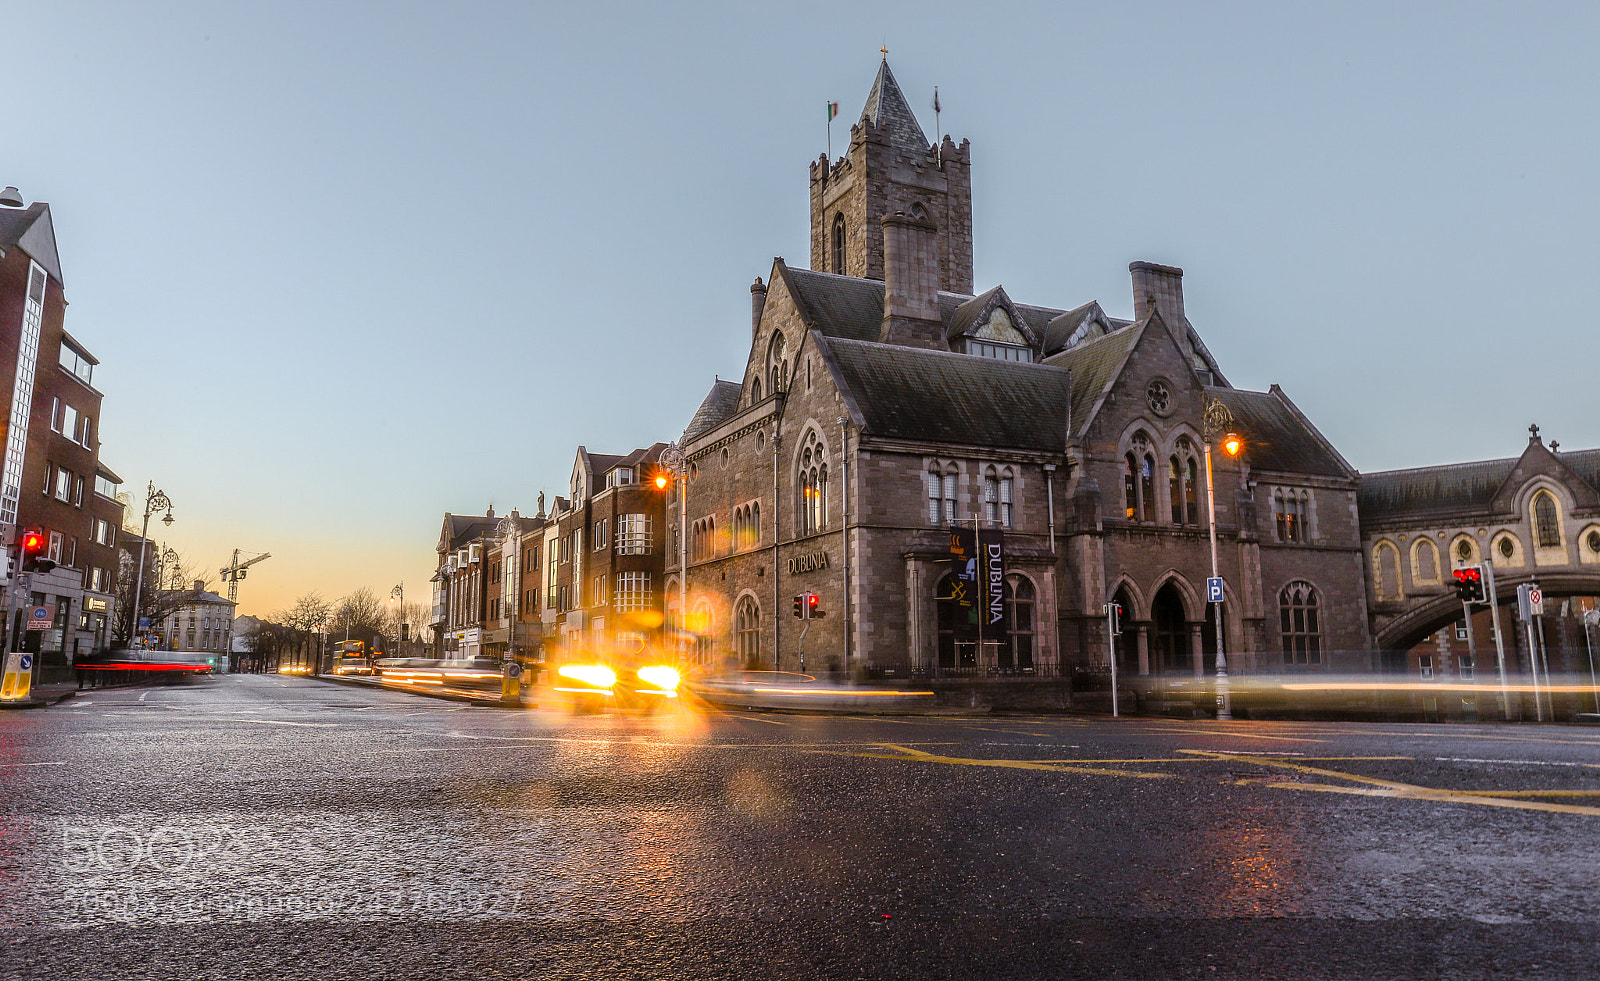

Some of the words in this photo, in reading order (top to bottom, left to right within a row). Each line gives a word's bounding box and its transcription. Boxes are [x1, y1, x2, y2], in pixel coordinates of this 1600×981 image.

[787, 551, 828, 574] DUBLINIA
[988, 543, 1003, 624] DUBLINIA
[1211, 587, 1220, 600] P
